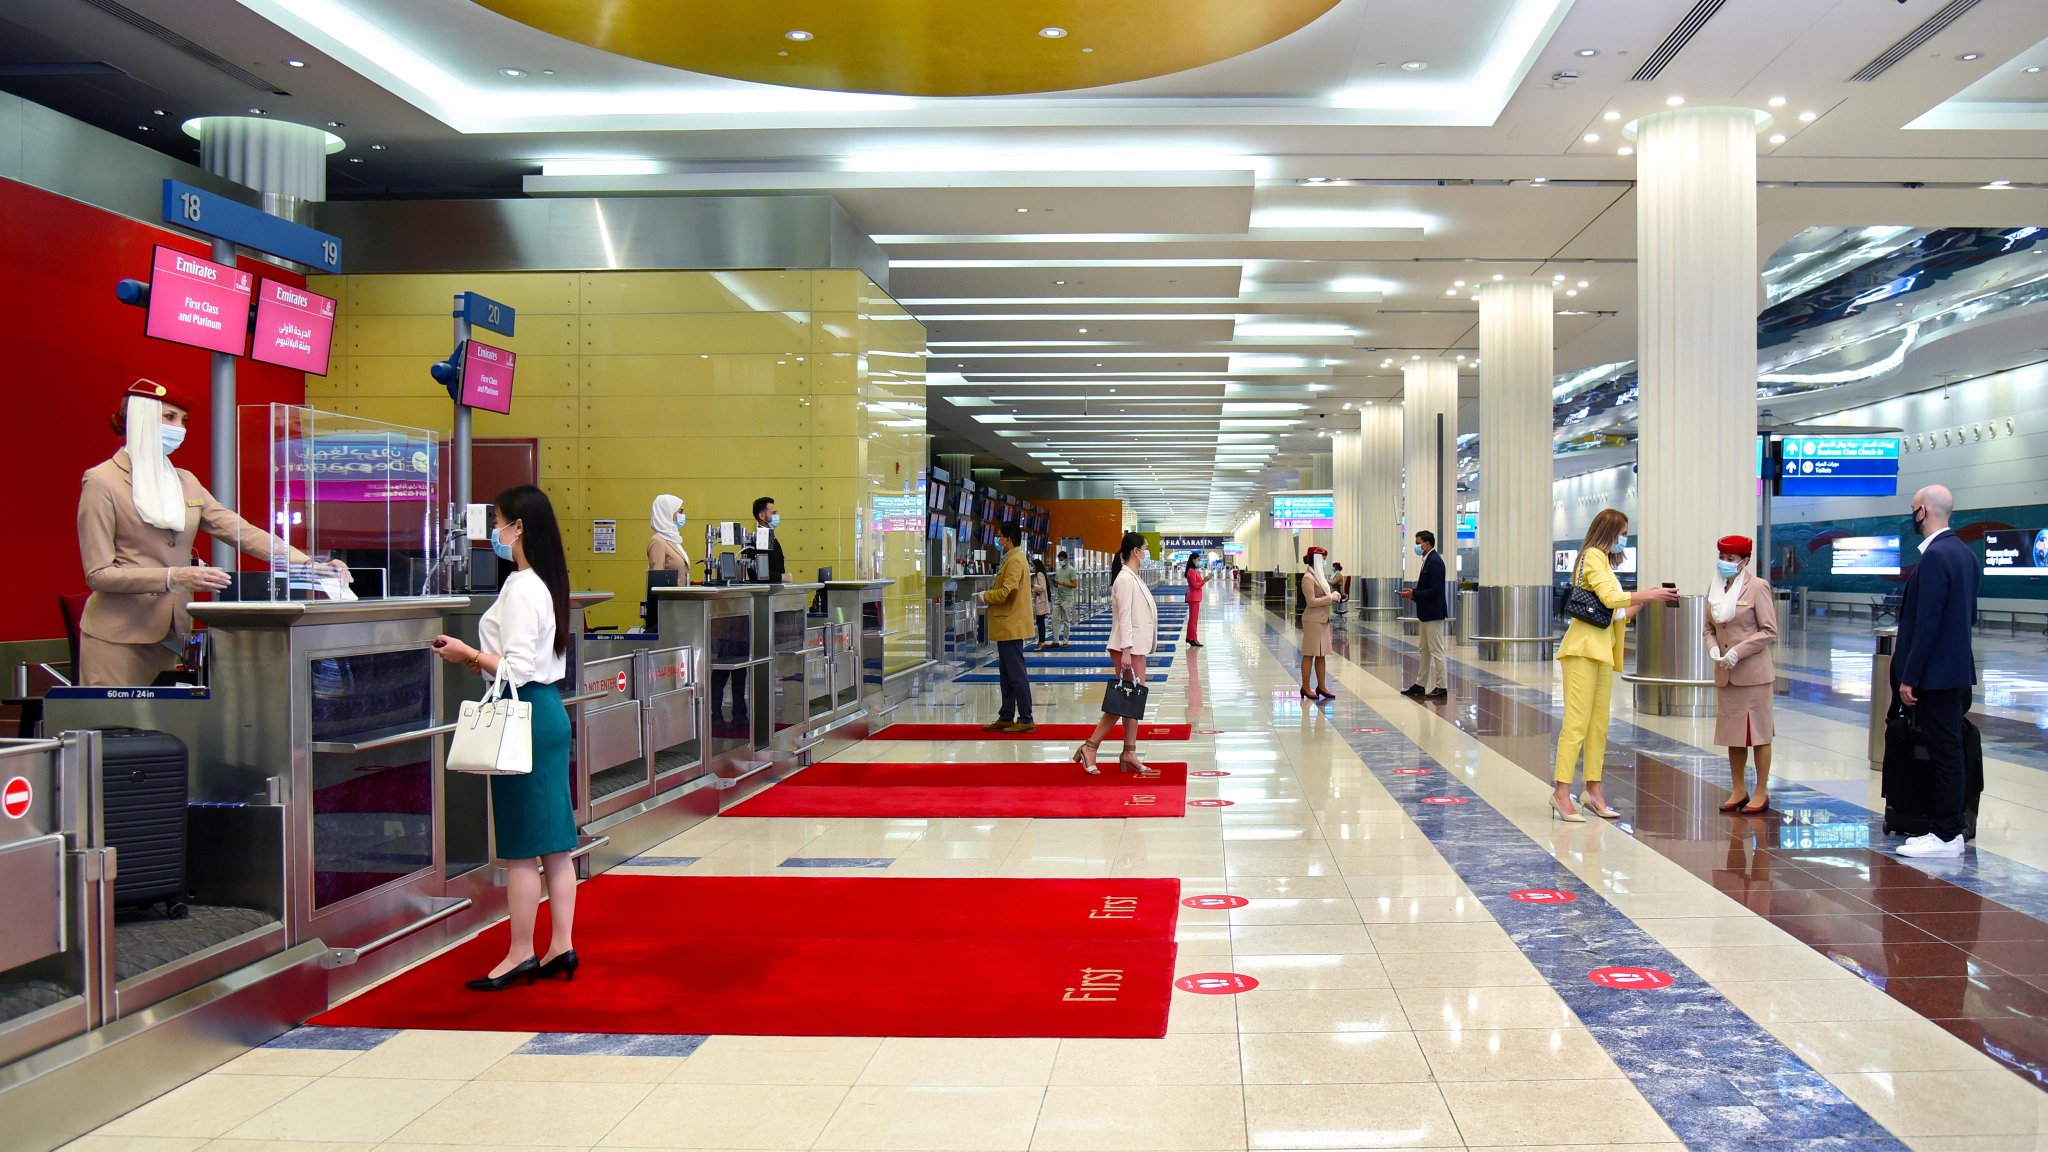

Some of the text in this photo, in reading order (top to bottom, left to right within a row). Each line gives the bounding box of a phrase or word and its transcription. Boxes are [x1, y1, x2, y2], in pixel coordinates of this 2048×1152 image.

[180, 192, 201, 222] 18
[321, 240, 338, 266] 19
[176, 256, 217, 280] Emirates
[185, 296, 219, 315] First Class
[276, 286, 308, 307] Emirates
[178, 312, 222, 330] and Platinum
[488, 304, 500, 325] 20
[477, 346, 498, 361] Emirates
[107, 690, 129, 698] 60cm
[136, 690, 155, 698] 24in
[588, 682, 600, 692] NOT
[600, 677, 618, 691] ENTER
[1089, 895, 1138, 918] First
[1062, 967, 1123, 1001] First
